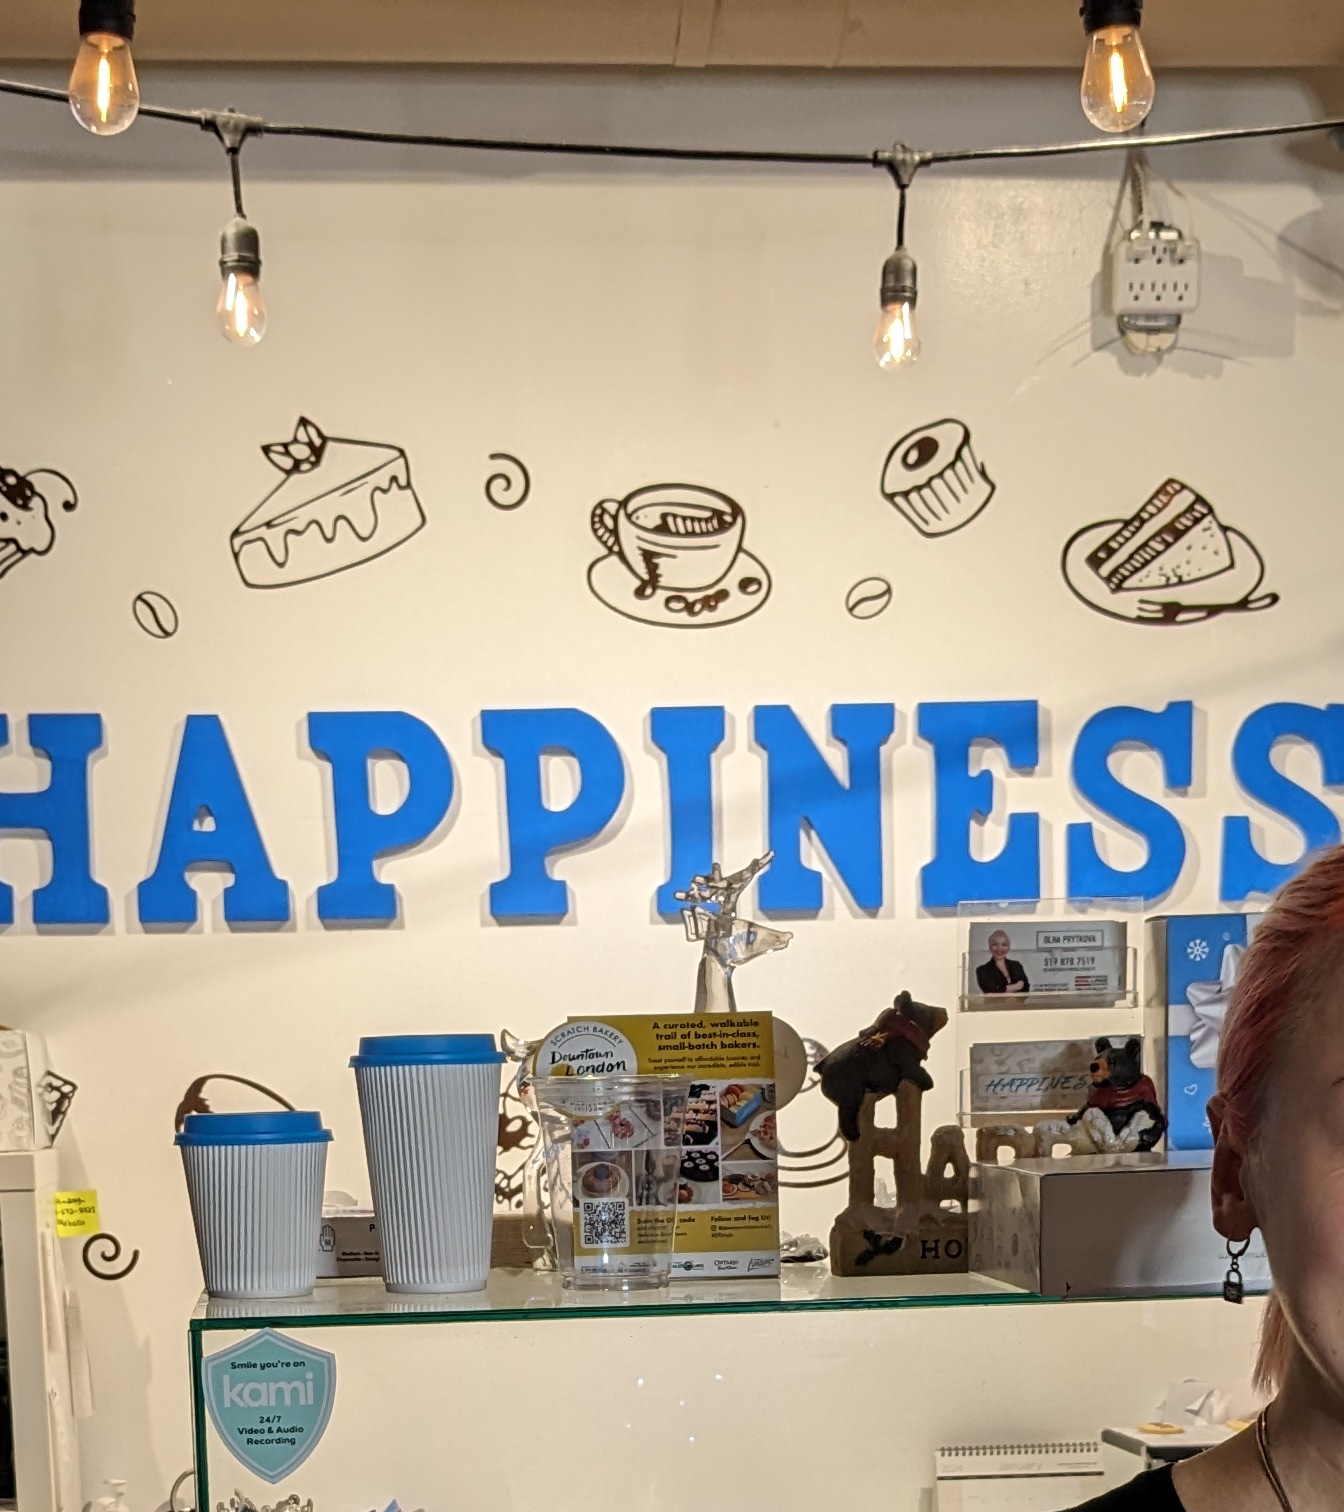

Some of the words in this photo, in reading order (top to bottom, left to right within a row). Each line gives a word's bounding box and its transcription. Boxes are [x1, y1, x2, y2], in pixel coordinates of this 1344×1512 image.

[652, 1021, 660, 1030] A
[710, 1019, 759, 1028] walkable
[550, 1025, 589, 1046] SCRATCH
[592, 1026, 625, 1045] BAKERY
[656, 1031, 678, 1040] trail
[681, 1031, 691, 1040] of
[720, 1040, 760, 1049] bakers.
[548, 1049, 613, 1064] Downtown
[565, 1060, 626, 1076] London
[231, 1361, 257, 1369] Smile
[260, 1360, 290, 1370] you're
[223, 1371, 314, 1408] kami
[259, 1415, 281, 1423] 24/7
[238, 1427, 265, 1435] Video
[246, 1437, 296, 1446] Recording
